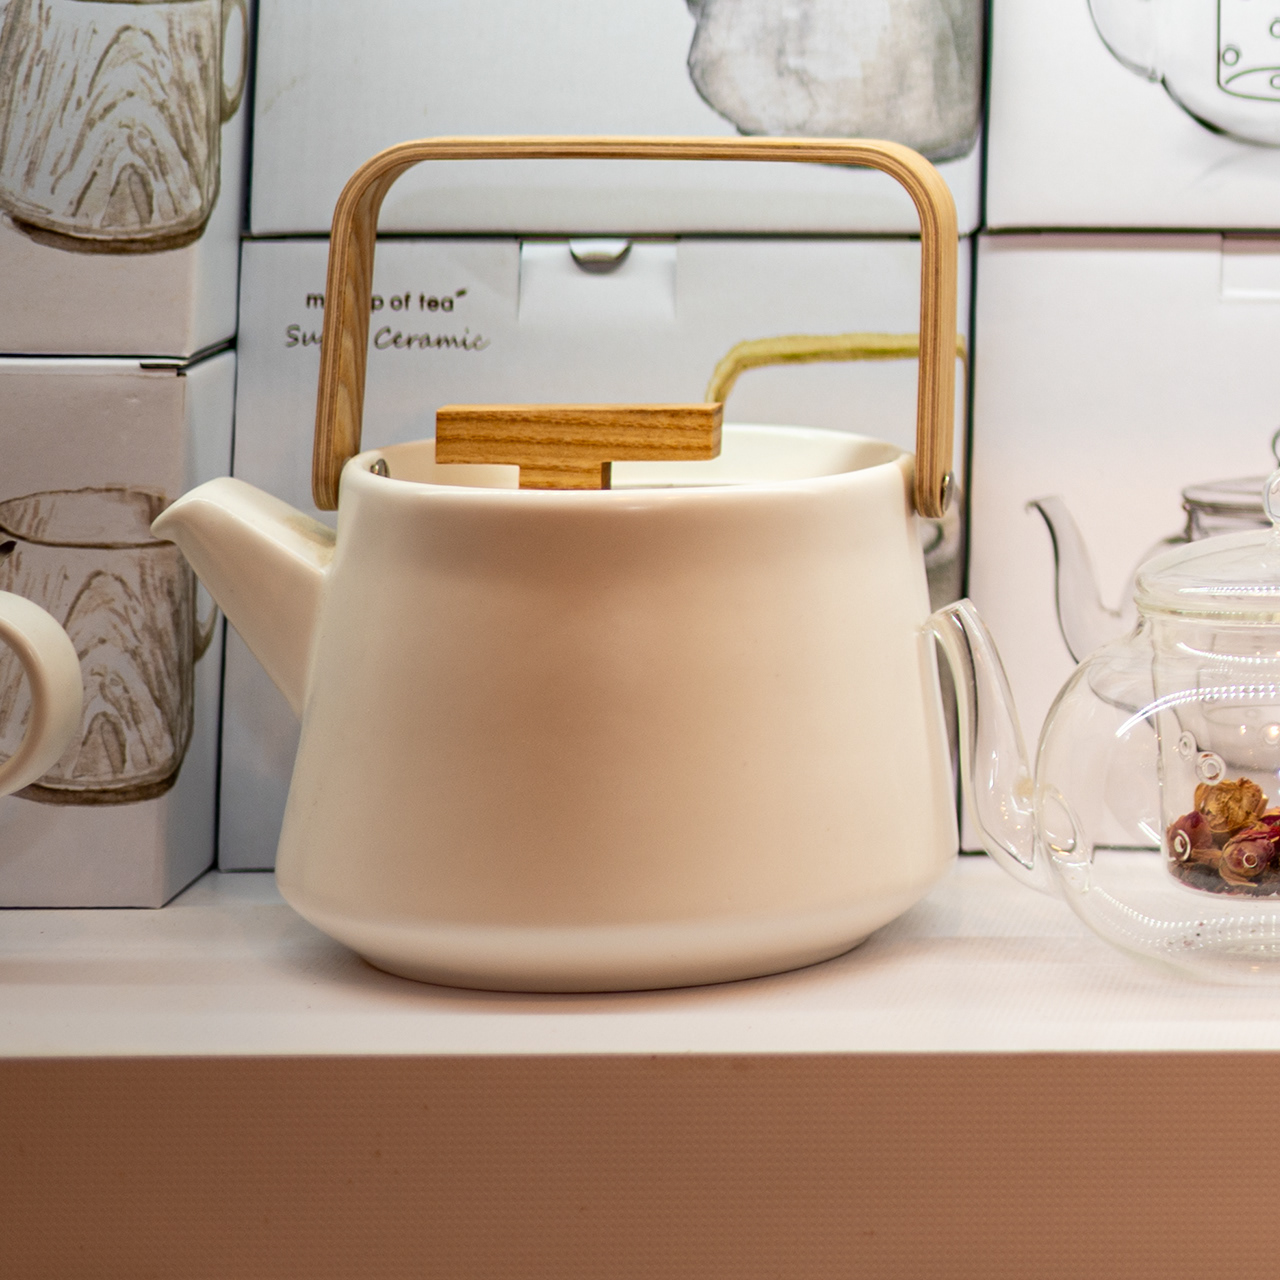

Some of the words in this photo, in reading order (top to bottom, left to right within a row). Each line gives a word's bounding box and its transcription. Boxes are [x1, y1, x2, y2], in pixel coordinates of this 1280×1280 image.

[390, 291, 412, 312] of
[419, 292, 454, 312] tea
[373, 326, 491, 352] Ceramic
